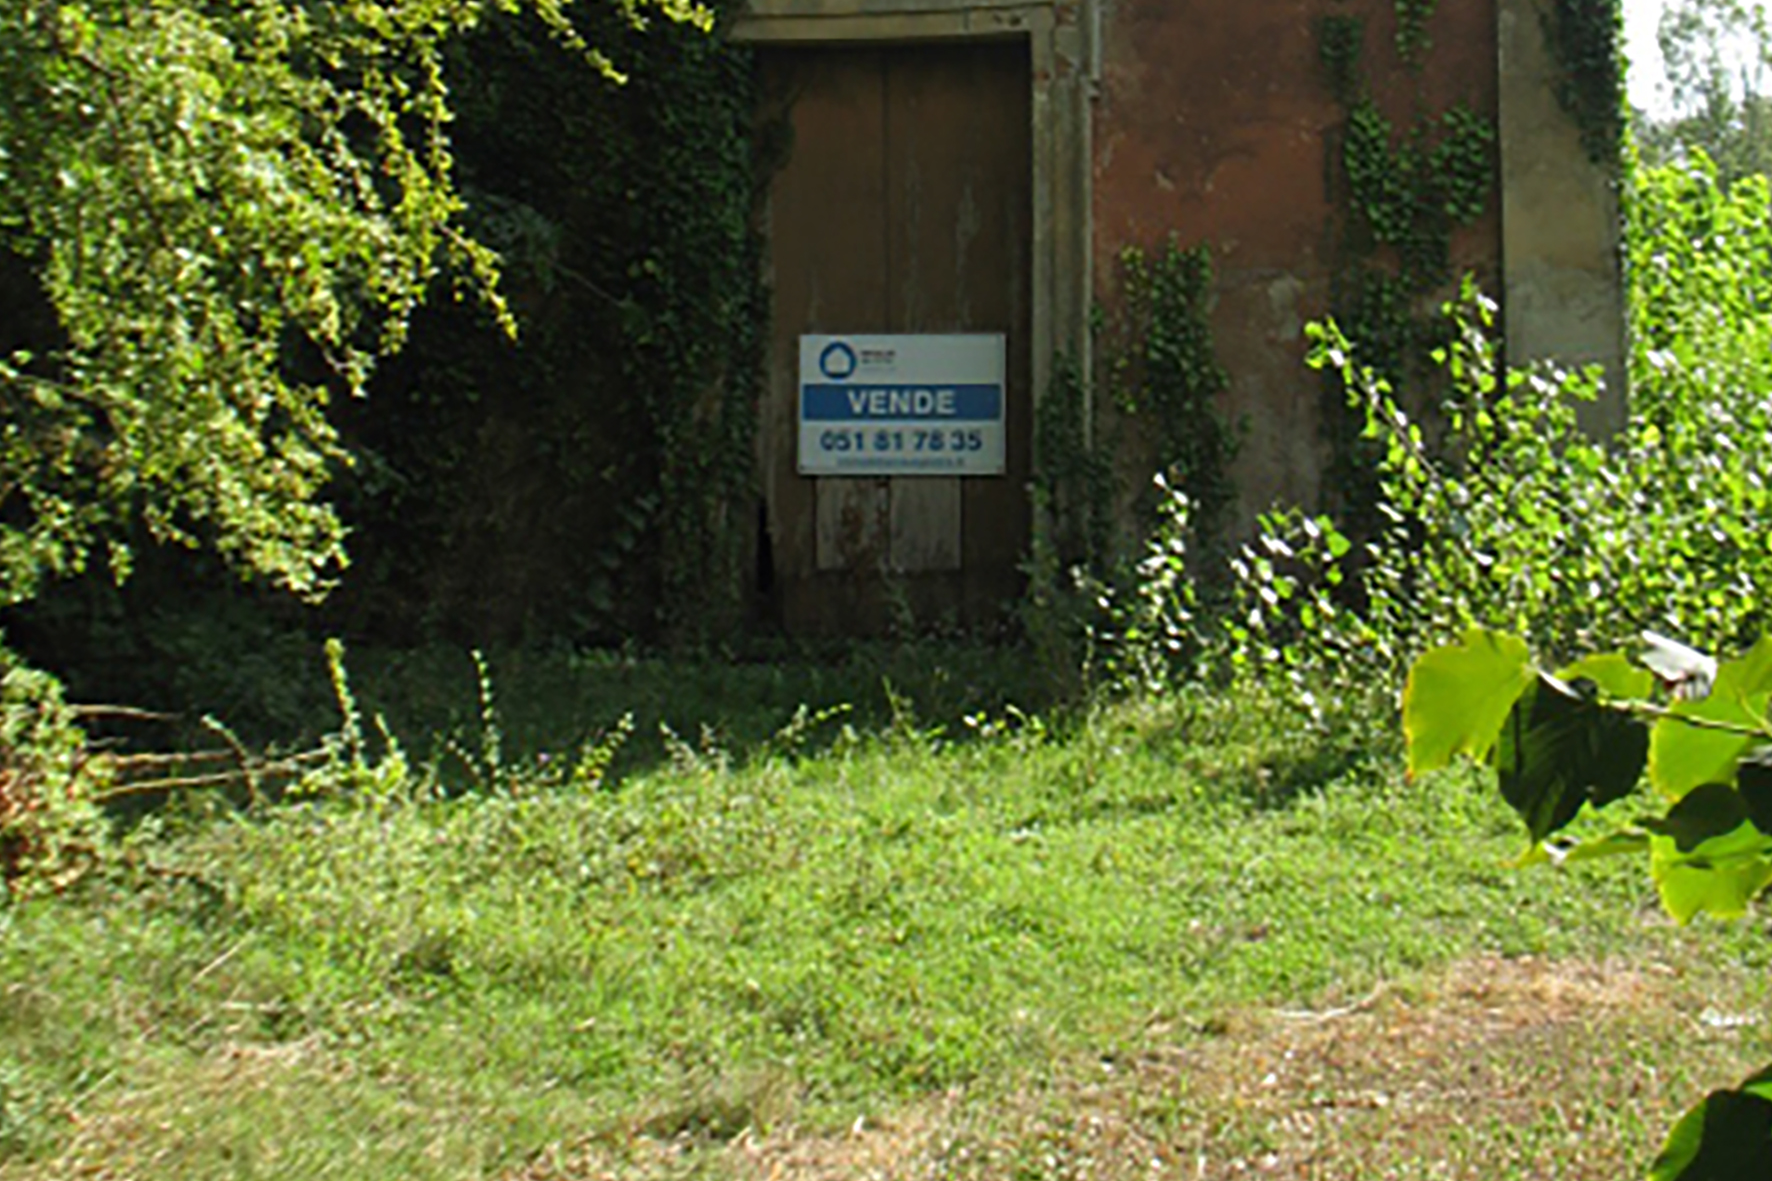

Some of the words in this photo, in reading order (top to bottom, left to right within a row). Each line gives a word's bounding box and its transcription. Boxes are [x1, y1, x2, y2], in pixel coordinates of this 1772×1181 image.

[847, 390, 956, 414] VENDE
[820, 430, 863, 451] 051
[873, 430, 903, 451] 81
[913, 430, 943, 451] 78
[951, 430, 982, 451] 35
